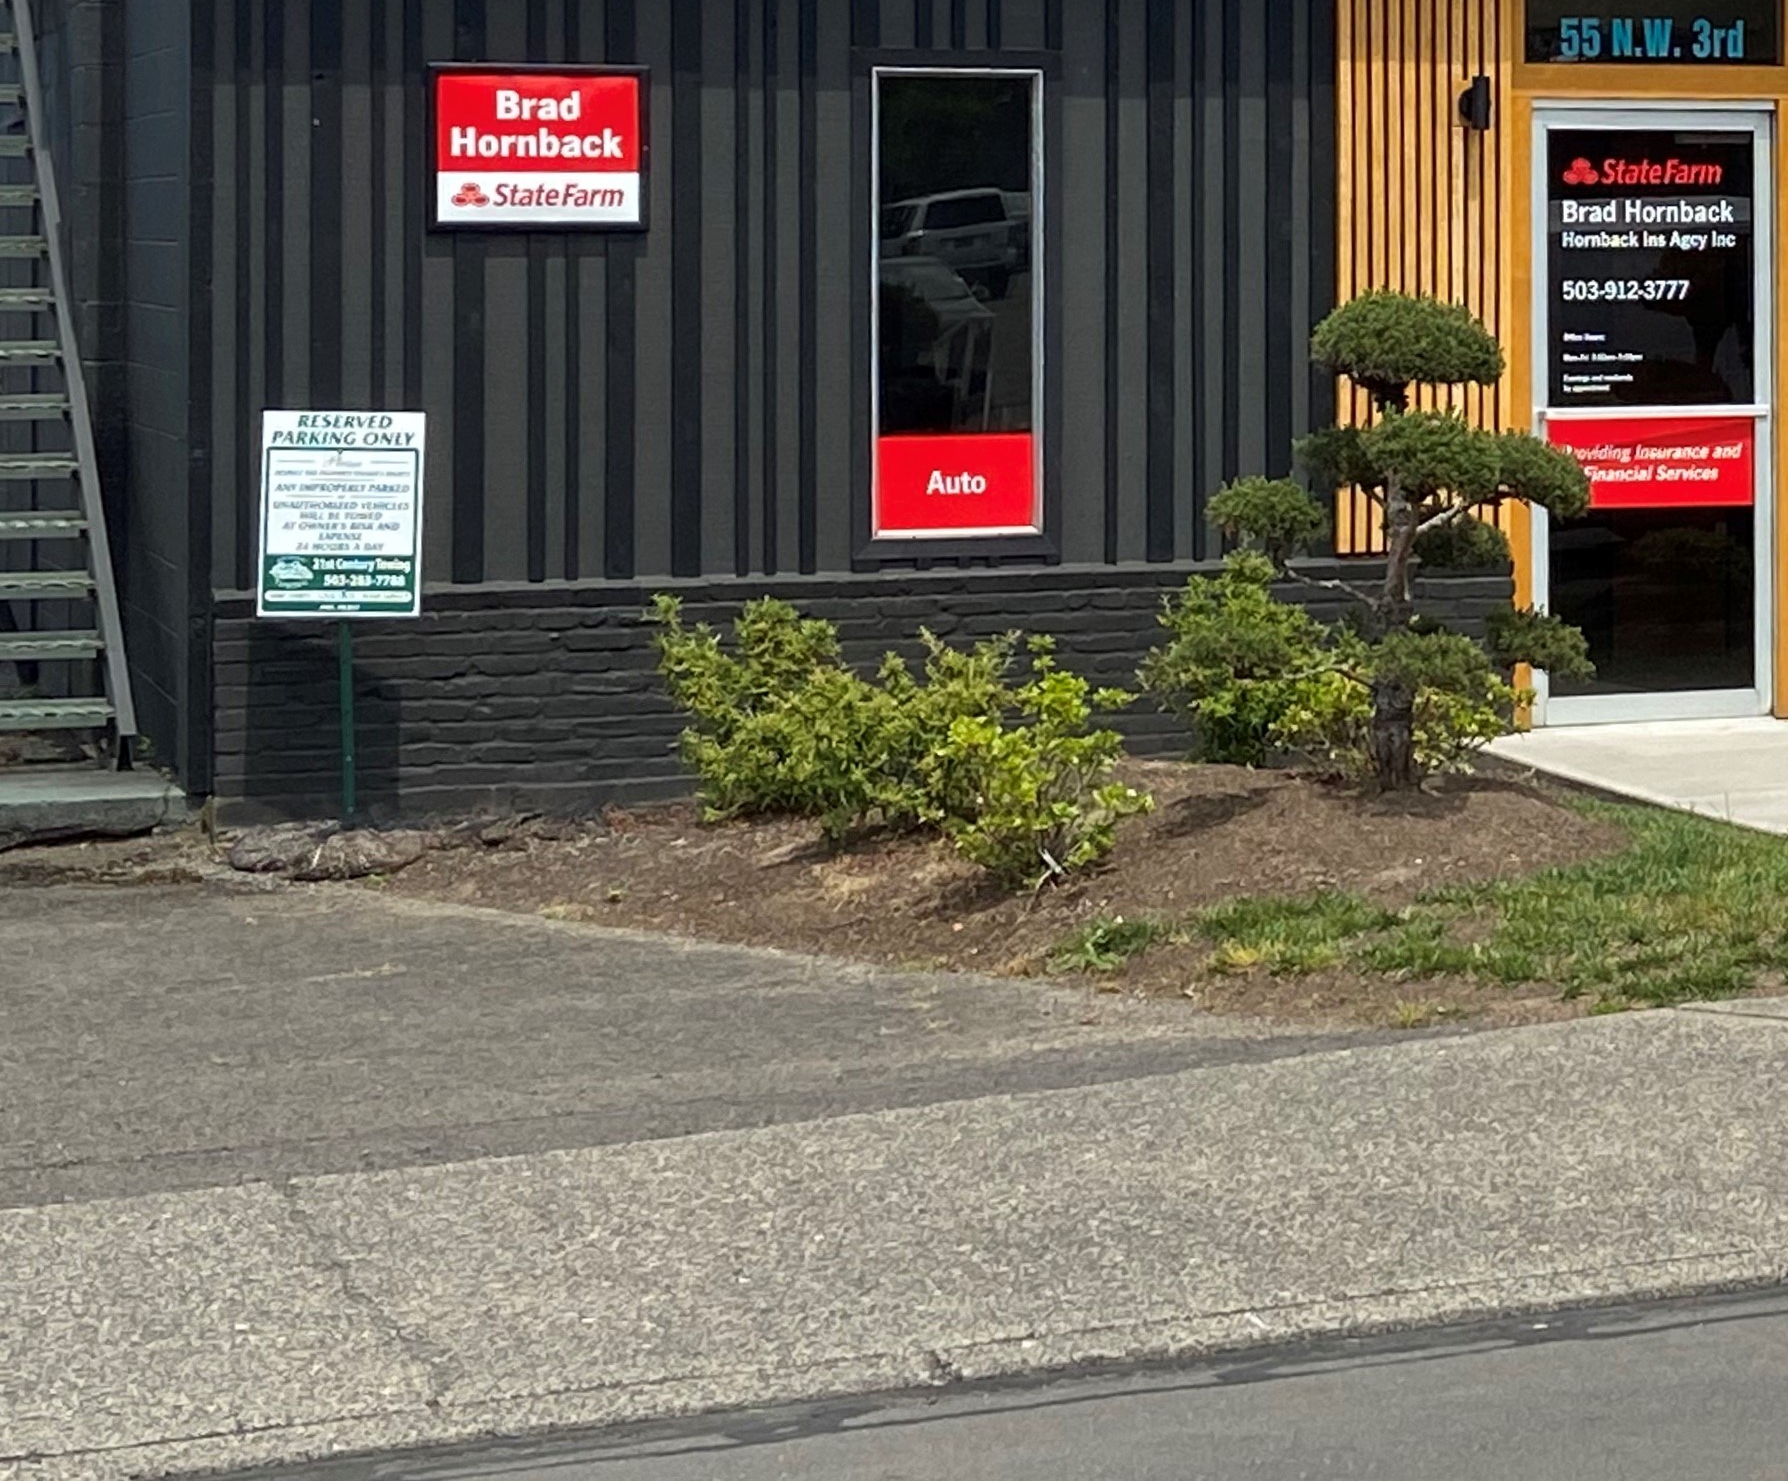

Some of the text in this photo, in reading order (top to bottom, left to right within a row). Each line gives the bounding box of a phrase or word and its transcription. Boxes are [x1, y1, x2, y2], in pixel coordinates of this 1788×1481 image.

[1560, 17, 1744, 59] 55 N.W. 3rd
[496, 90, 581, 121] Brad
[450, 126, 623, 158] Hornback
[1561, 200, 1734, 223] Brad Hornback
[1561, 231, 1736, 250] Hornback Ins Agcy Inc
[1562, 280, 1690, 301] 503-912-3777
[298, 414, 393, 429] RESERVED
[271, 430, 415, 447] PARKING ONLY
[1635, 442, 1709, 461] Insurance
[1712, 441, 1744, 459] and
[926, 470, 987, 495] Auto
[1655, 465, 1719, 482] Services
